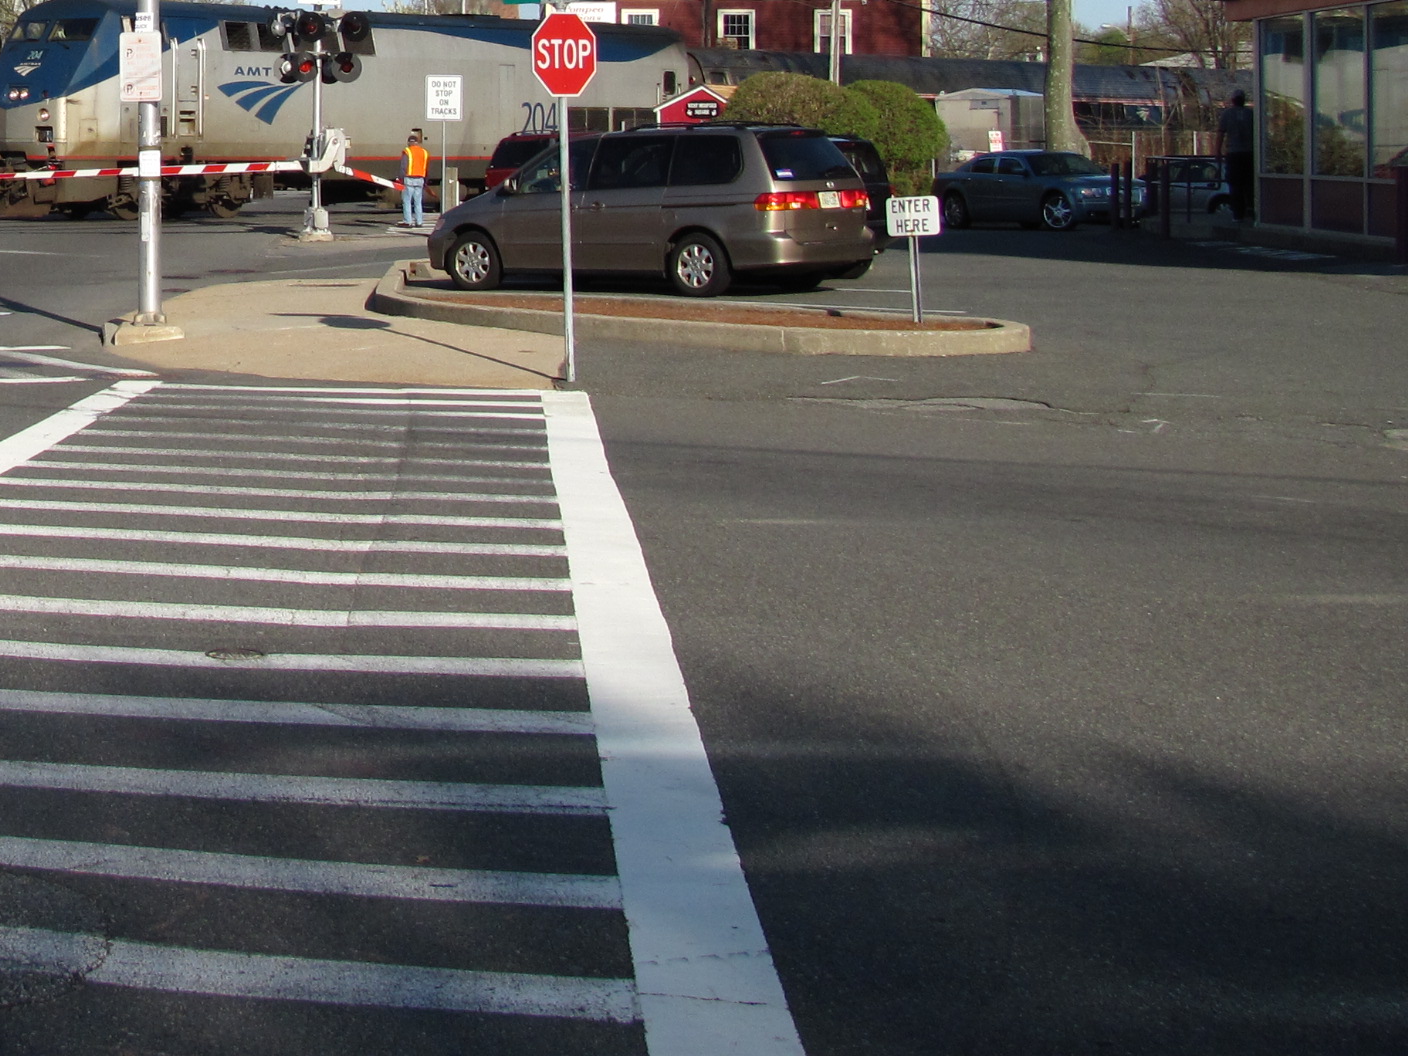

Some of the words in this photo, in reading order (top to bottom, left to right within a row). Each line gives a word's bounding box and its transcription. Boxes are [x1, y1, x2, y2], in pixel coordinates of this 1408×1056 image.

[537, 38, 591, 70] STOP
[233, 66, 272, 77] AMT
[431, 80, 442, 88] DO
[443, 80, 457, 88] NOT
[435, 89, 453, 97] STOP
[439, 98, 449, 106] ON
[430, 107, 457, 115] TRACKS
[521, 102, 558, 135] 204
[891, 198, 931, 214] ENTER
[896, 218, 929, 233] HERE
